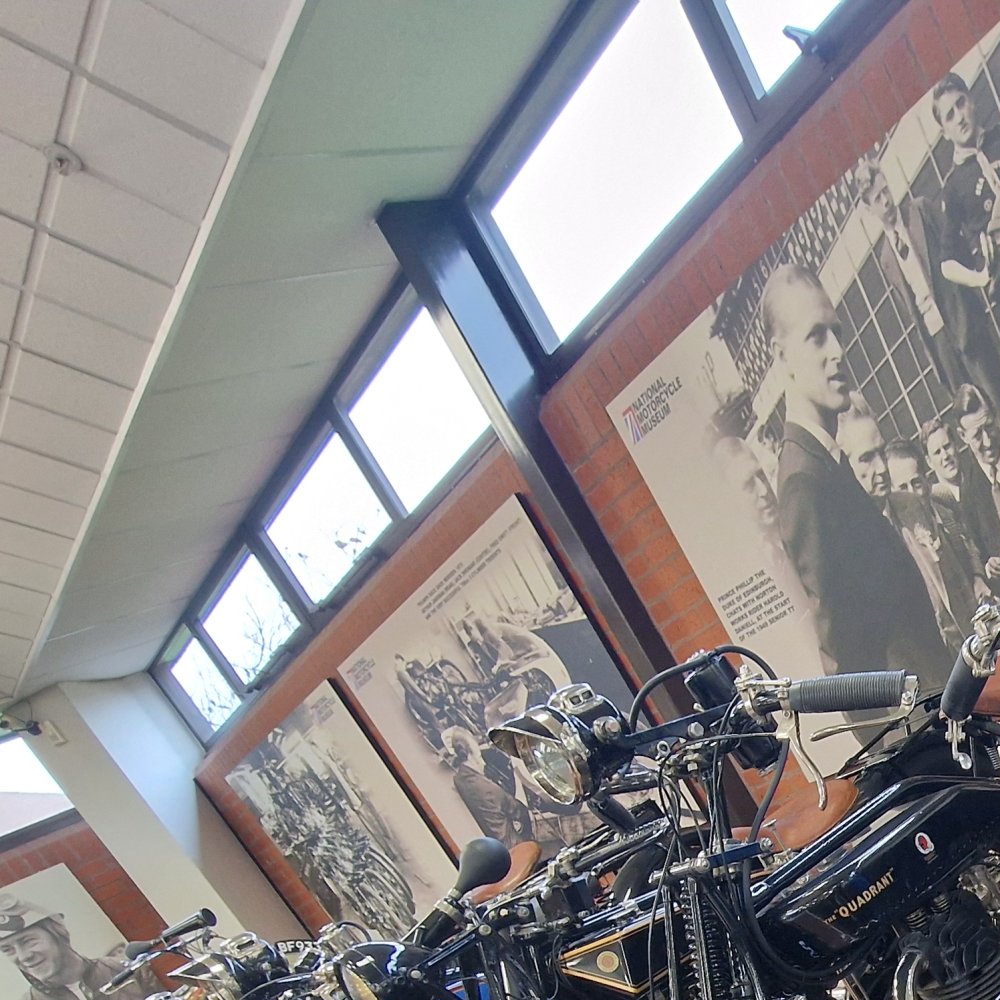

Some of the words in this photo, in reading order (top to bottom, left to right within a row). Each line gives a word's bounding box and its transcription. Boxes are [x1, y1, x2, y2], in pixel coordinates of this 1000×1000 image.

[631, 376, 667, 411] NATIONAL
[637, 376, 682, 422] MOTORCYCLE
[641, 402, 671, 435] MUSEUM
[718, 589, 736, 603] PRINCE
[754, 569, 766, 579] THE
[726, 606, 743, 618] CHATS
[742, 598, 756, 609] WITH
[755, 584, 777, 600] NORTON
[722, 599, 736, 611] DUKE
[730, 612, 748, 626] WORKS
[748, 604, 764, 615] RIDER
[763, 591, 784, 606] HAROLD
[763, 607, 775, 618] THE
[774, 597, 791, 611] START
[746, 628, 757, 637] THE
[768, 610, 788, 625] SENIOR
[823, 915, 837, 925] THE
